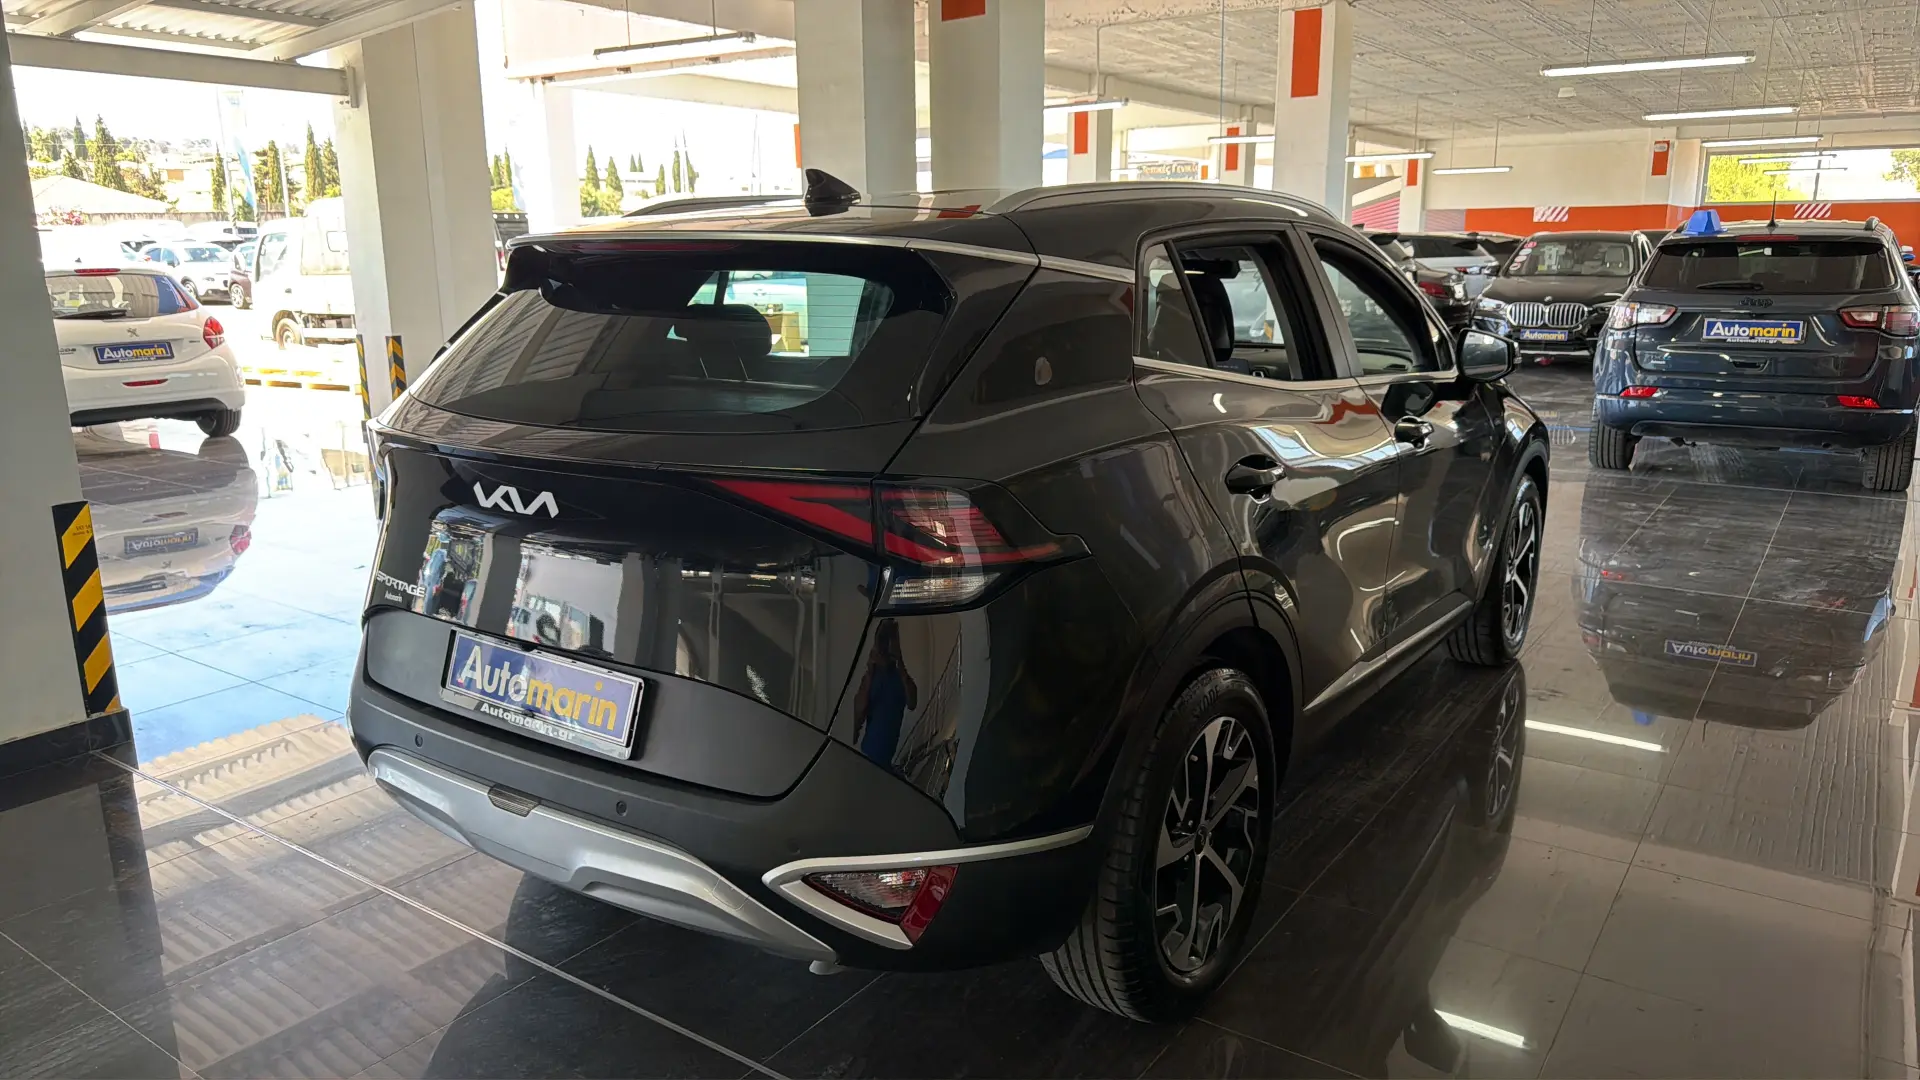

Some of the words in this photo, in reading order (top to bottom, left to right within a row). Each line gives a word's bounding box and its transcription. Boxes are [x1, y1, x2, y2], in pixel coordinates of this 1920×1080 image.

[1523, 330, 1565, 341] Automarin
[1710, 321, 1795, 338] Automarin
[103, 344, 166, 359] Automarin
[376, 570, 426, 597] SPORTAGE
[457, 645, 618, 731] Automarin
[480, 702, 576, 741] Automarin.gr
